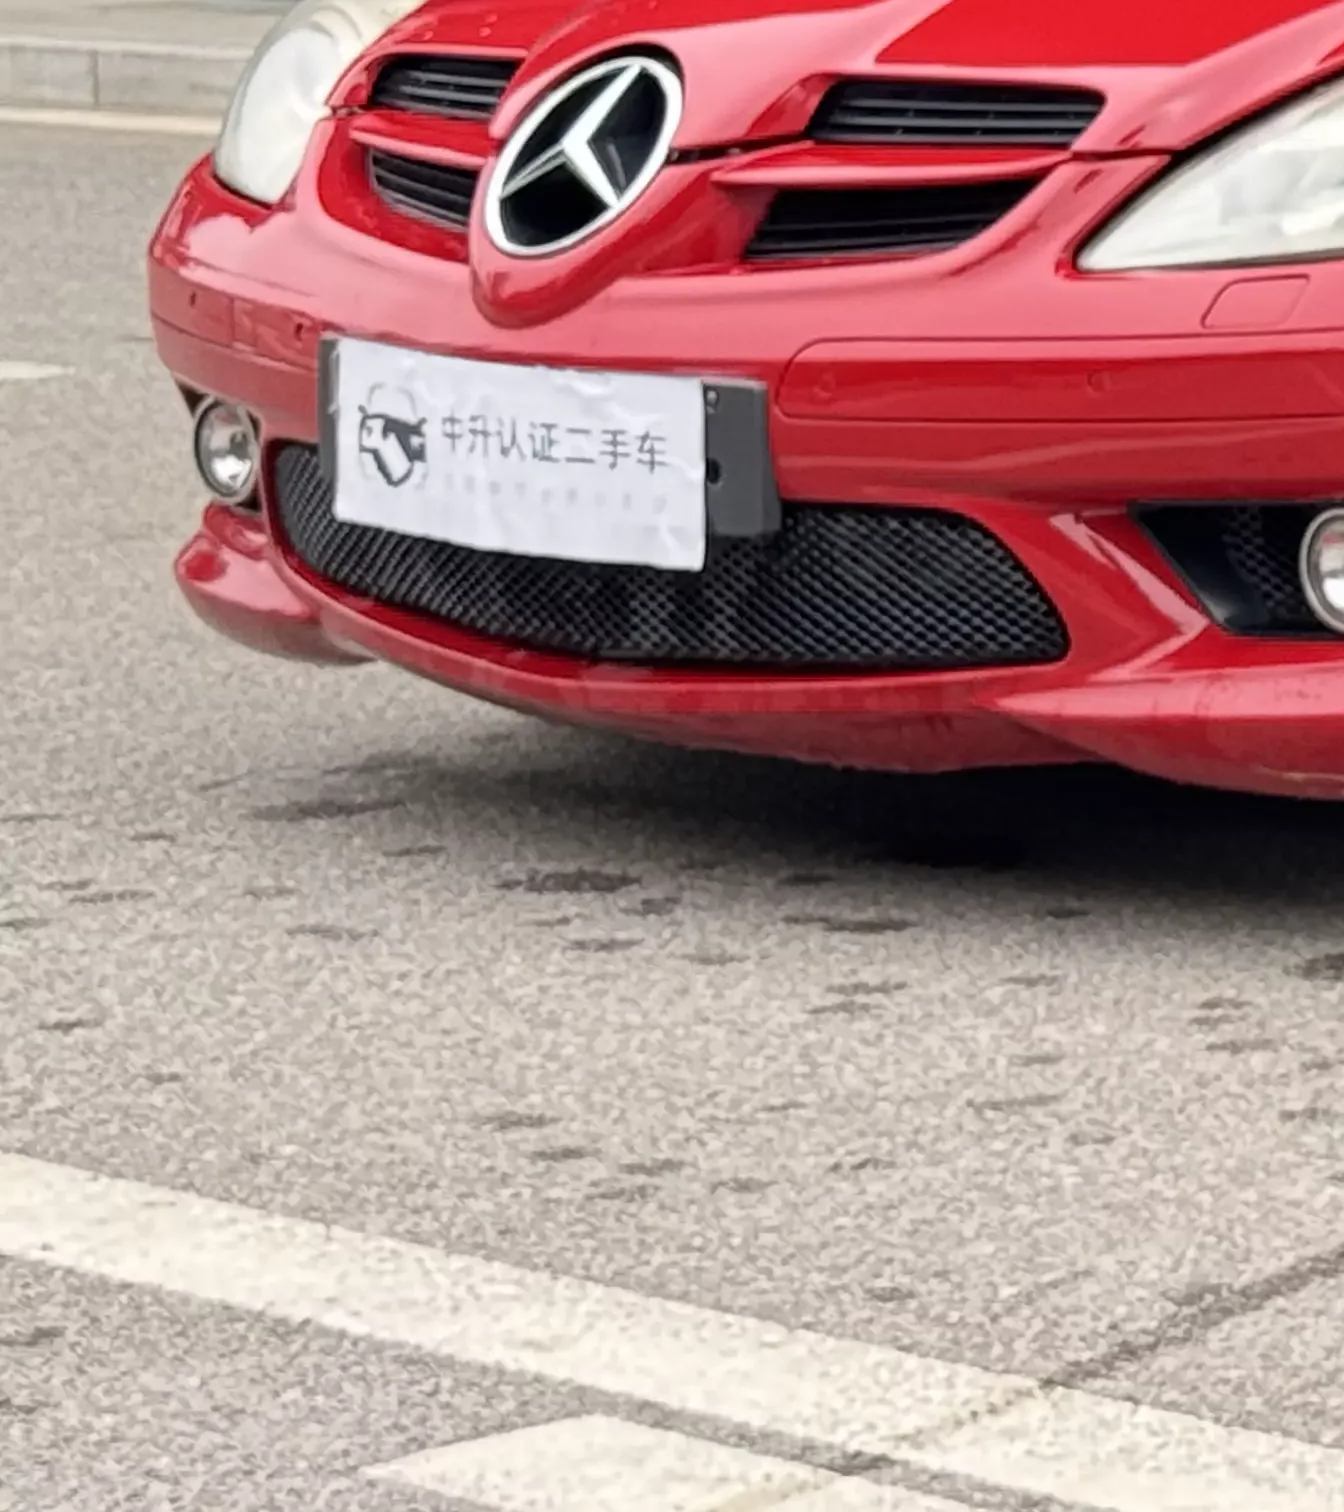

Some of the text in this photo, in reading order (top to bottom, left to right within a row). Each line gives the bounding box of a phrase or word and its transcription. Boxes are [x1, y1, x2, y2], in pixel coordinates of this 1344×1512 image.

[441, 407, 669, 474] 中升认证二手车
